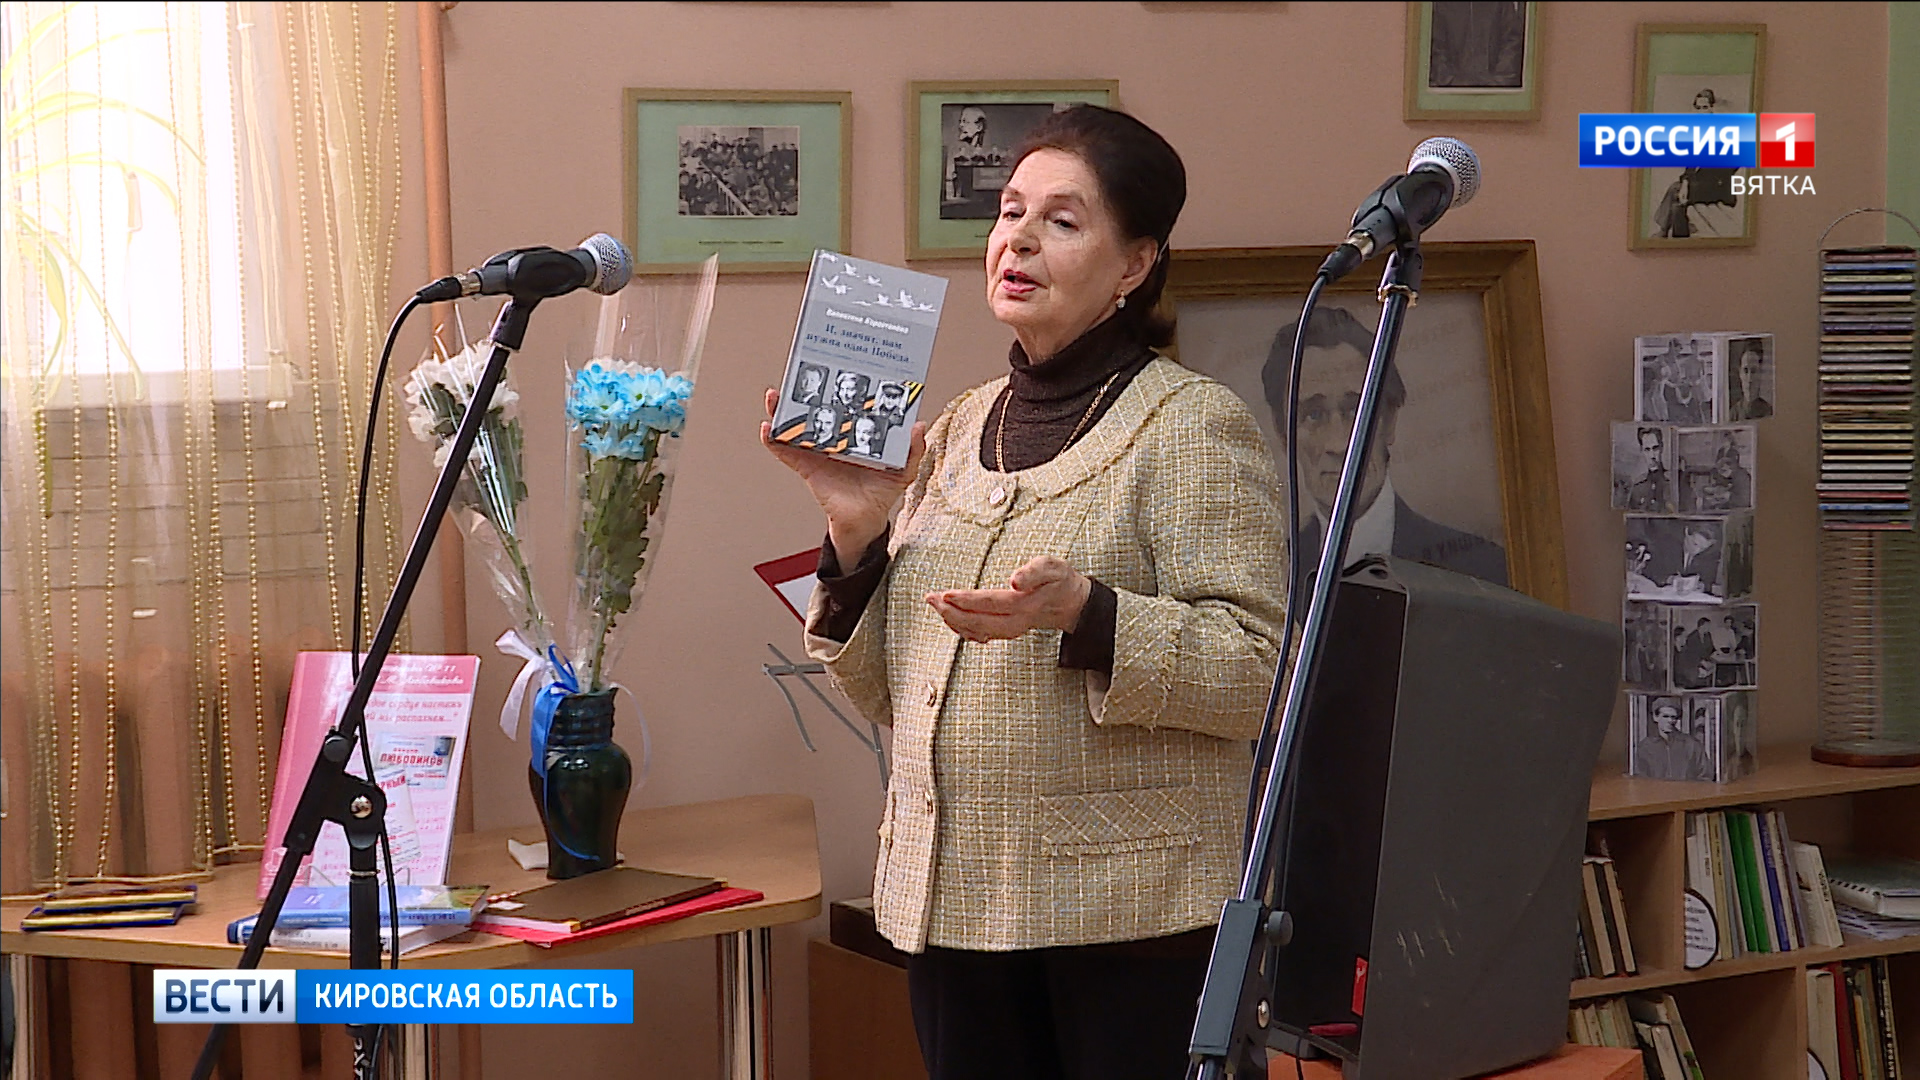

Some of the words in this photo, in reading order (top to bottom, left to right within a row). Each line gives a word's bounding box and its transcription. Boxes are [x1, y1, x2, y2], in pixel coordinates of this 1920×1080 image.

[806, 332, 841, 348] нужна
[844, 342, 869, 354] одна
[841, 329, 879, 344] значит,
